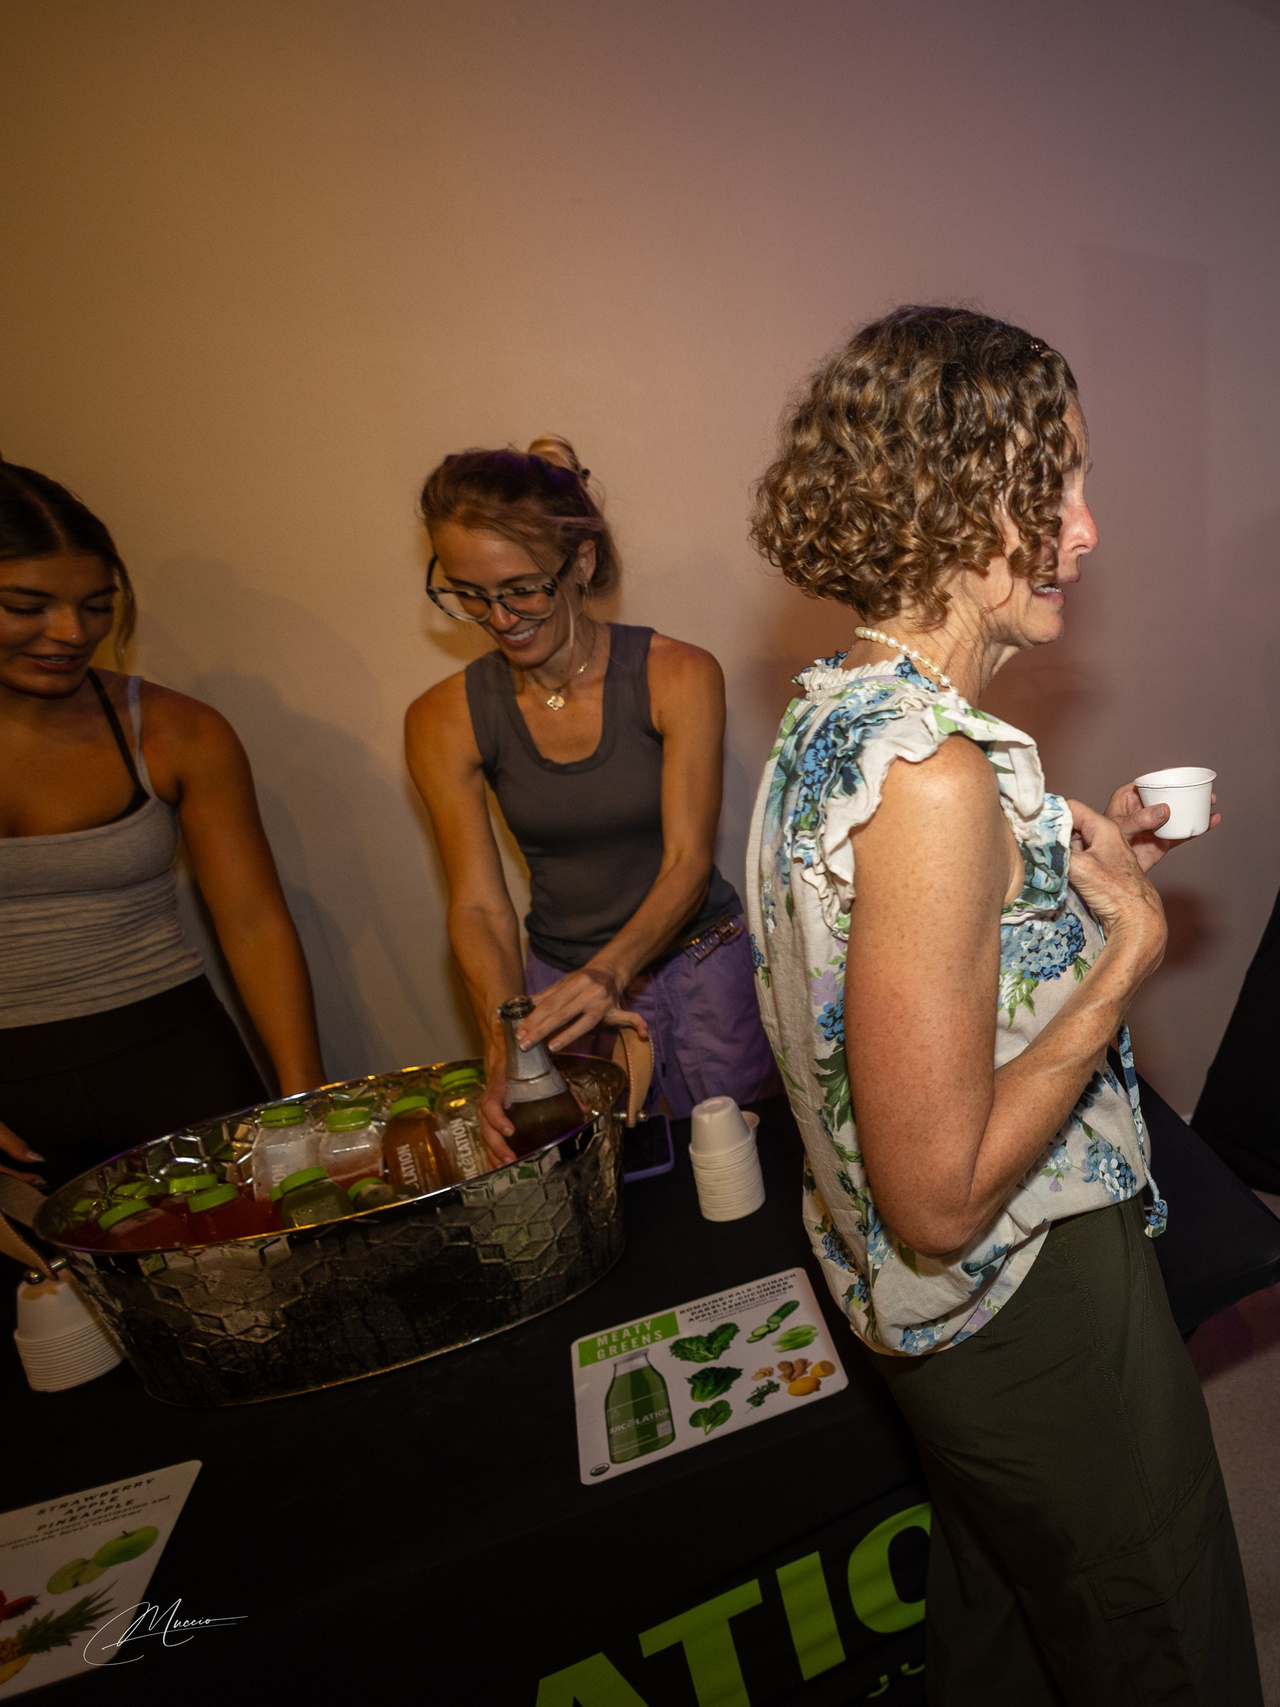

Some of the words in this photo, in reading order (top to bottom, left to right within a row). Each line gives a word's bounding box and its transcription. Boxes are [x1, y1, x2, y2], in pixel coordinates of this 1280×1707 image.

[396, 1143, 419, 1191] LATION
[597, 1321, 652, 1347] MEATY
[597, 1330, 663, 1360] GREENS
[36, 1477, 156, 1516] STRAWBERRY
[63, 1495, 120, 1516] APPLE
[151, 1495, 171, 1504] and
[36, 1499, 136, 1531] PINEAPPLE
